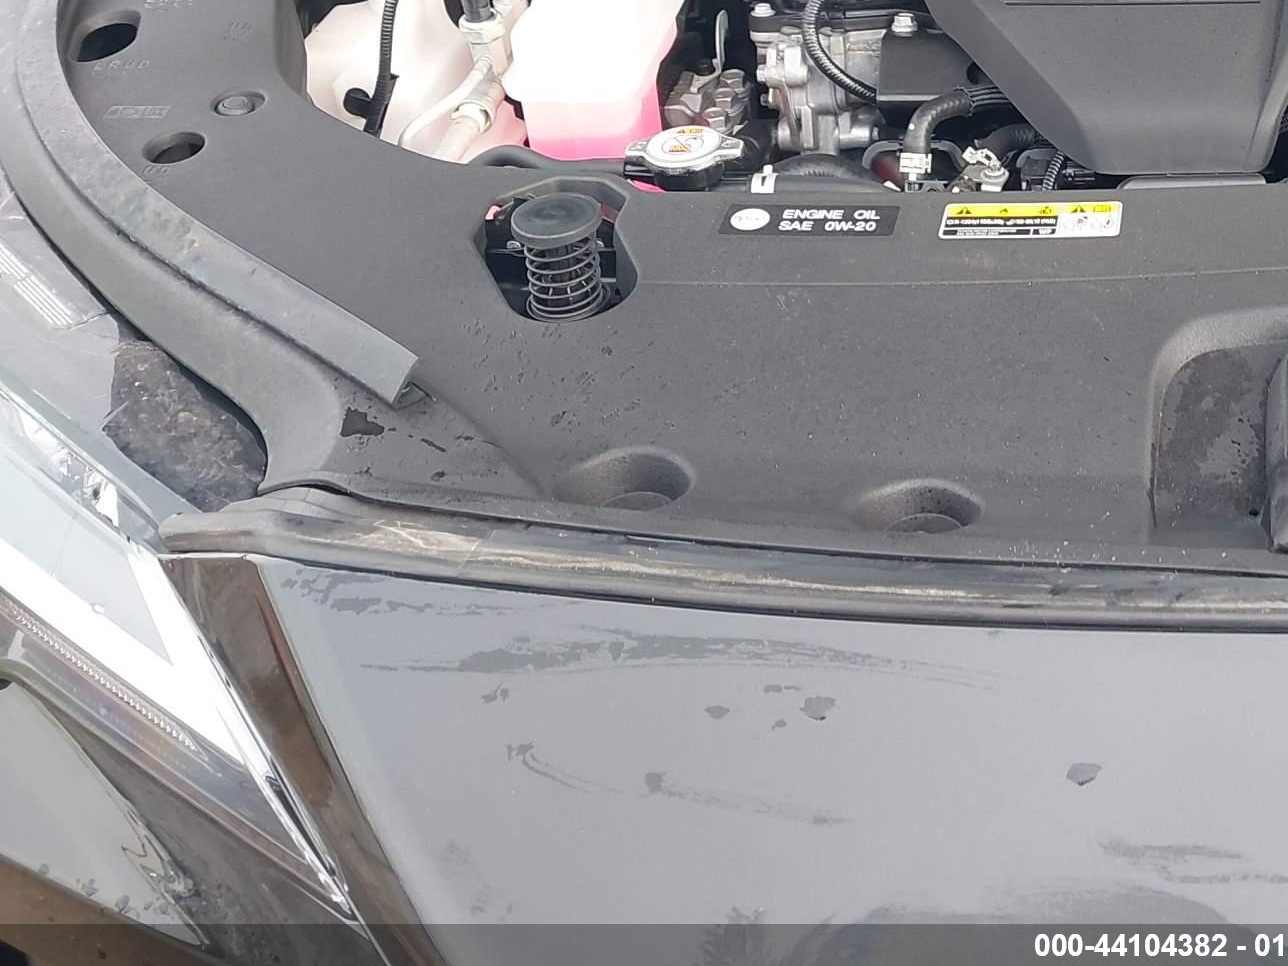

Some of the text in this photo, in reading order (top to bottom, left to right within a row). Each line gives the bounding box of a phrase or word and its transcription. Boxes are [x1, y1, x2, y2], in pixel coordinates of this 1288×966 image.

[782, 209, 844, 220] ENGINE
[853, 209, 881, 220] OIL
[778, 220, 877, 232] SAE 0W-20
